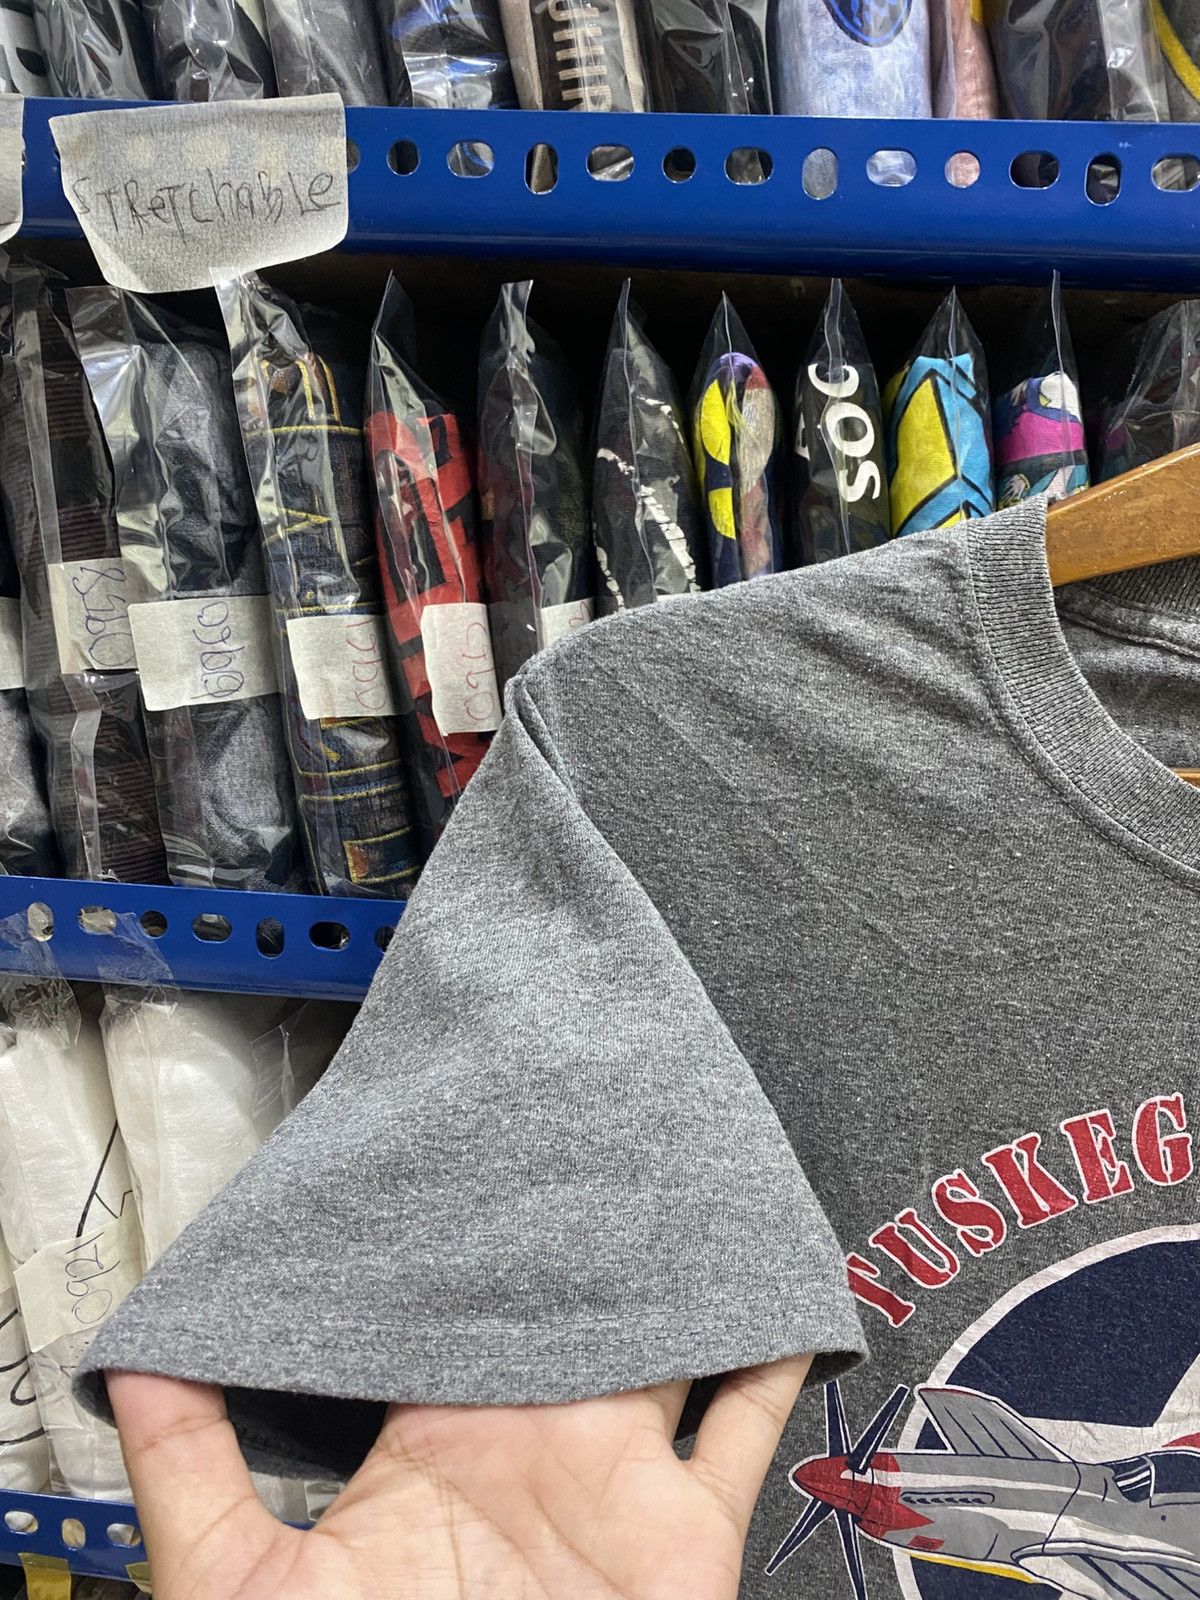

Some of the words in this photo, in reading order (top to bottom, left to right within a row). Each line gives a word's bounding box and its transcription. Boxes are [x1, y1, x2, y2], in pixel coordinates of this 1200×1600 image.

[72, 566, 133, 667] 0958
[845, 1091, 1194, 1328] TUSKEG
[65, 1231, 121, 1325] 0921
